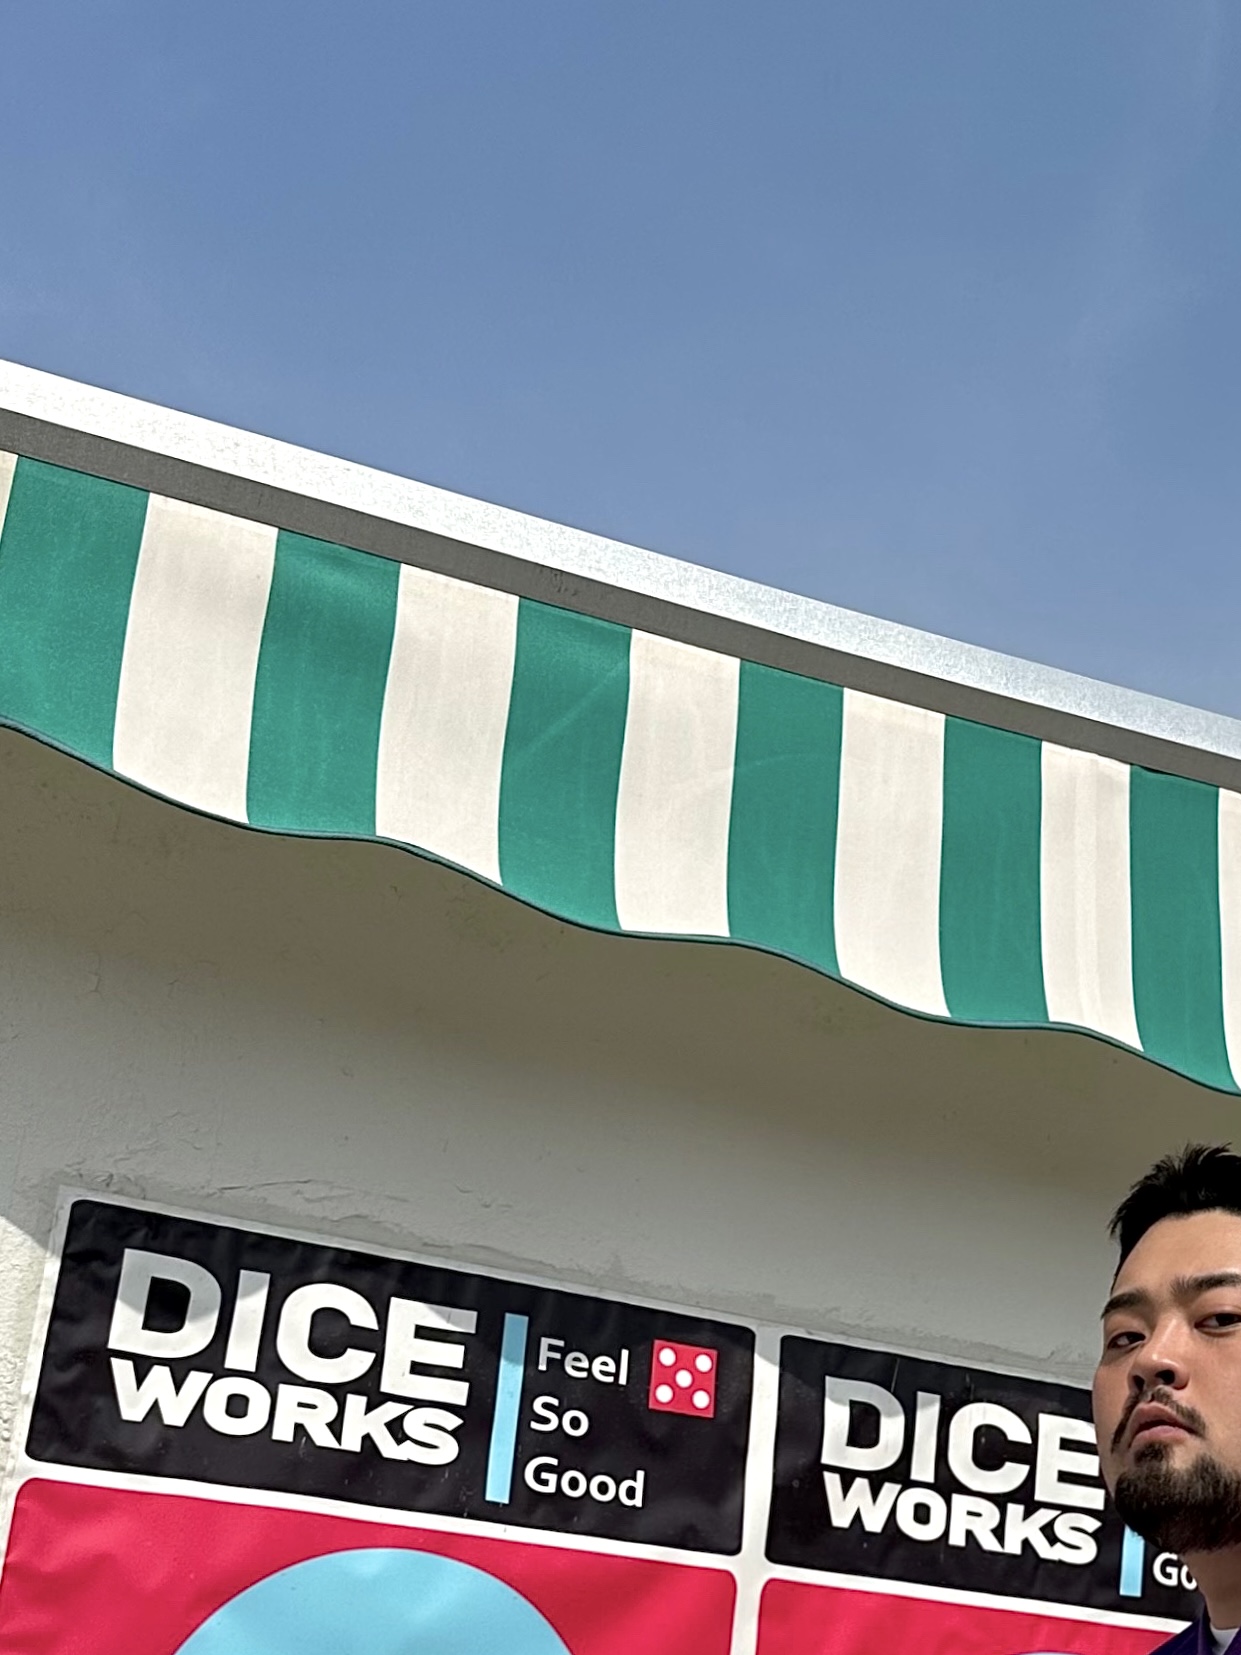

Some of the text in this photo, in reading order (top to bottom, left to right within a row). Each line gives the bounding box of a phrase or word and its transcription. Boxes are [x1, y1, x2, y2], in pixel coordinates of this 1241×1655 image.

[107, 1247, 478, 1407] DICE
[537, 1336, 630, 1386] Feel
[109, 1356, 464, 1466] WORKS
[530, 1395, 589, 1437] So
[820, 1375, 1106, 1511] DICE
[523, 1456, 645, 1508] Good
[823, 1470, 1103, 1566] WORKS
[1152, 1551, 1198, 1592] Go
